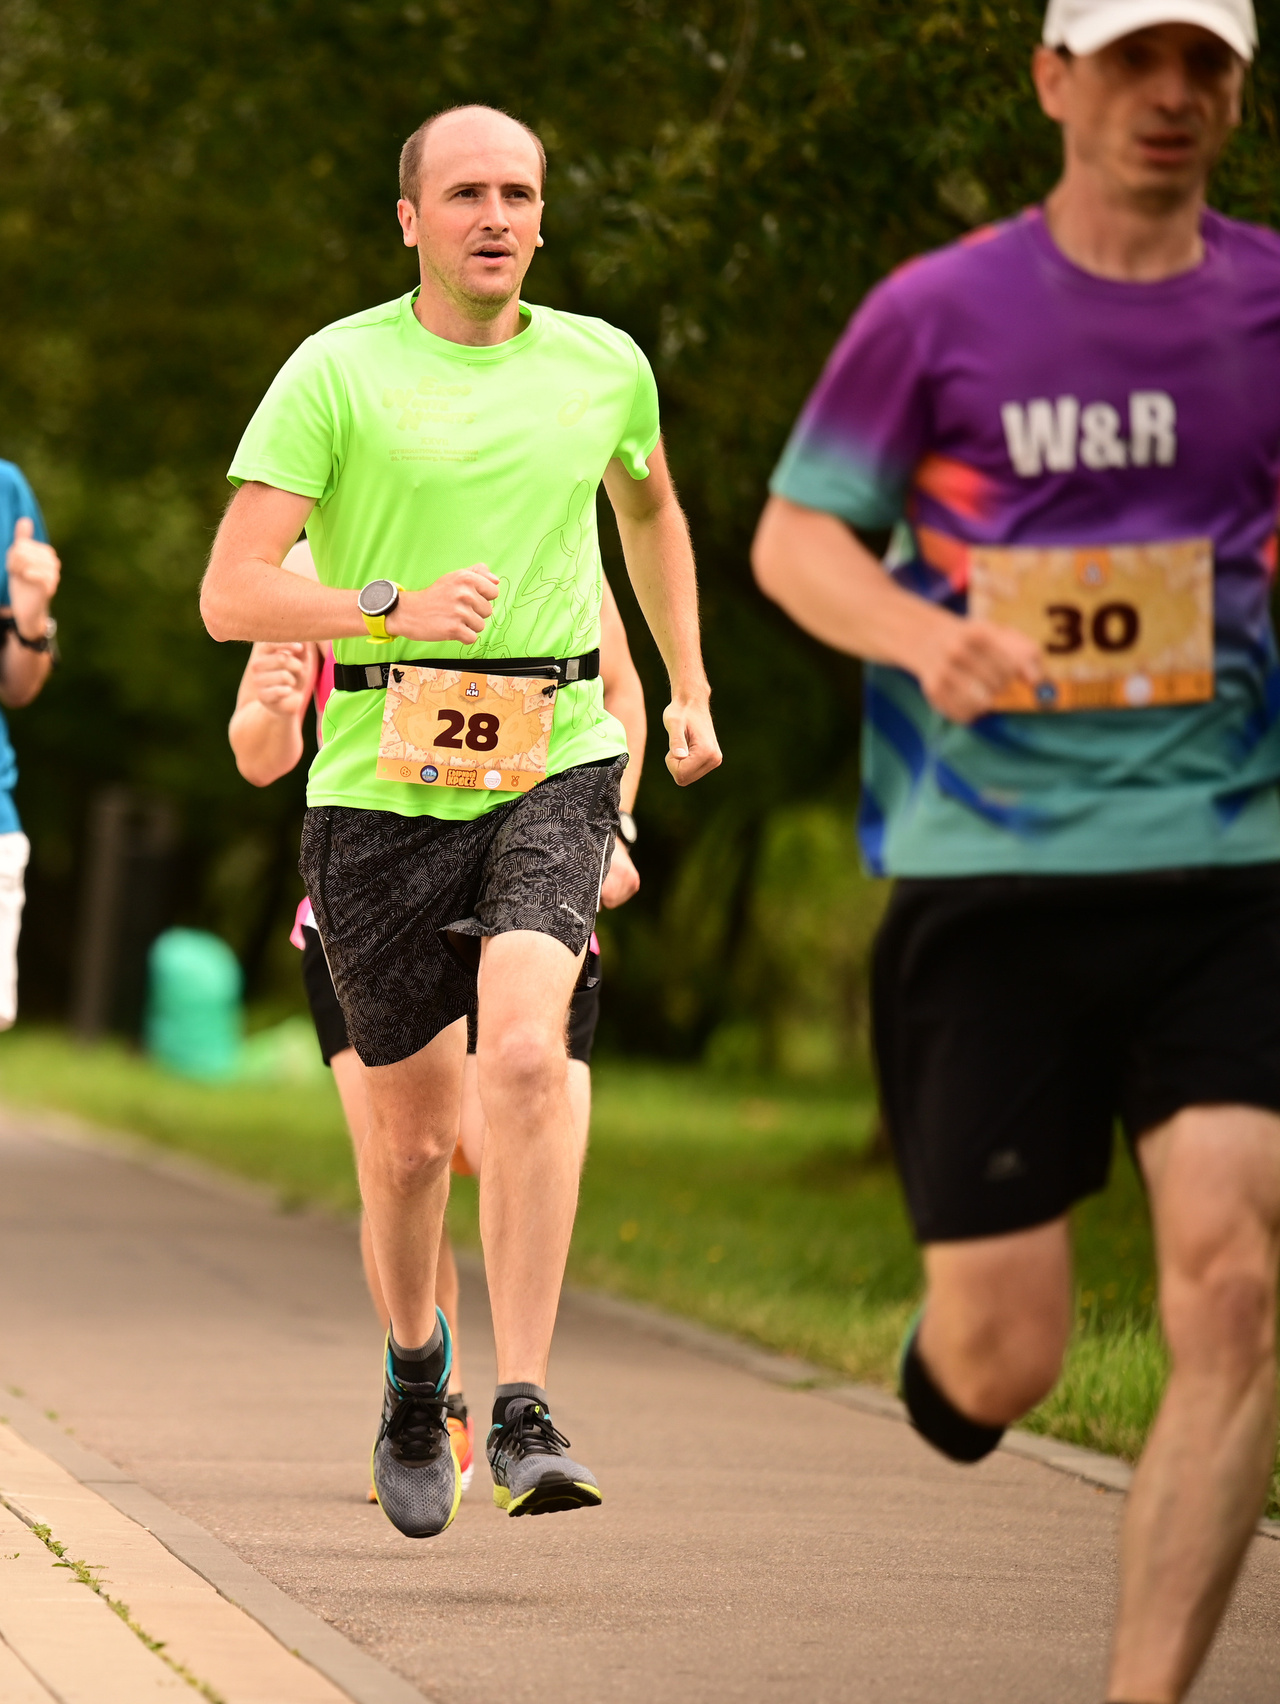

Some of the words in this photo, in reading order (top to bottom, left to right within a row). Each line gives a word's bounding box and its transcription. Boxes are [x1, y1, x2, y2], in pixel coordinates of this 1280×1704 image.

[1001, 390, 1177, 478] W&R
[1044, 602, 1140, 656] 30
[470, 682, 476, 690] 5
[433, 709, 500, 752] 28
